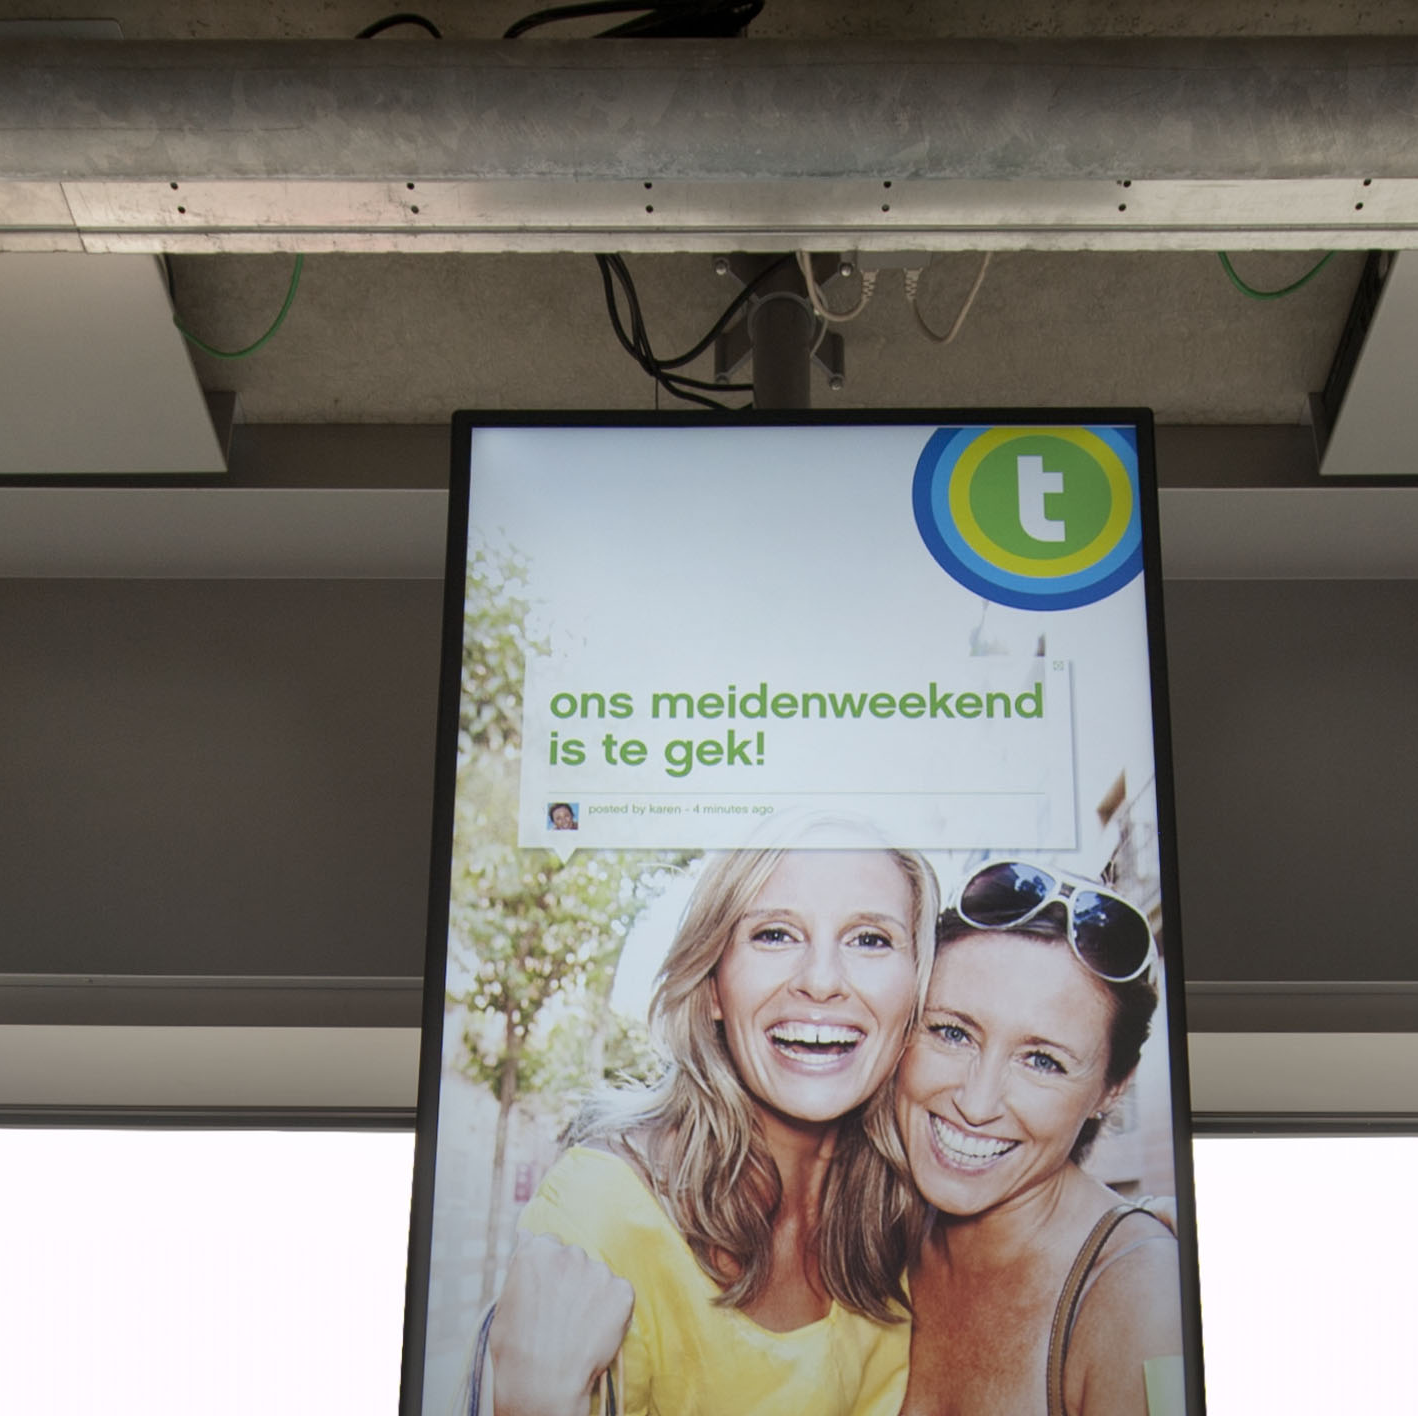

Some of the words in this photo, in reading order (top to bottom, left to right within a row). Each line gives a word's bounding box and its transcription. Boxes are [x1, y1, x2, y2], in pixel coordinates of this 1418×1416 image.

[1016, 455, 1066, 543] t
[549, 692, 634, 719] ons
[651, 680, 1044, 719] meidenweekend
[549, 730, 586, 767] is
[601, 733, 648, 766] te
[664, 728, 765, 778] gek!
[588, 803, 629, 815] posted
[631, 803, 646, 816] by
[648, 803, 682, 814] karen
[692, 803, 700, 814] 4
[702, 804, 750, 815] minutes
[751, 805, 775, 817] ago
